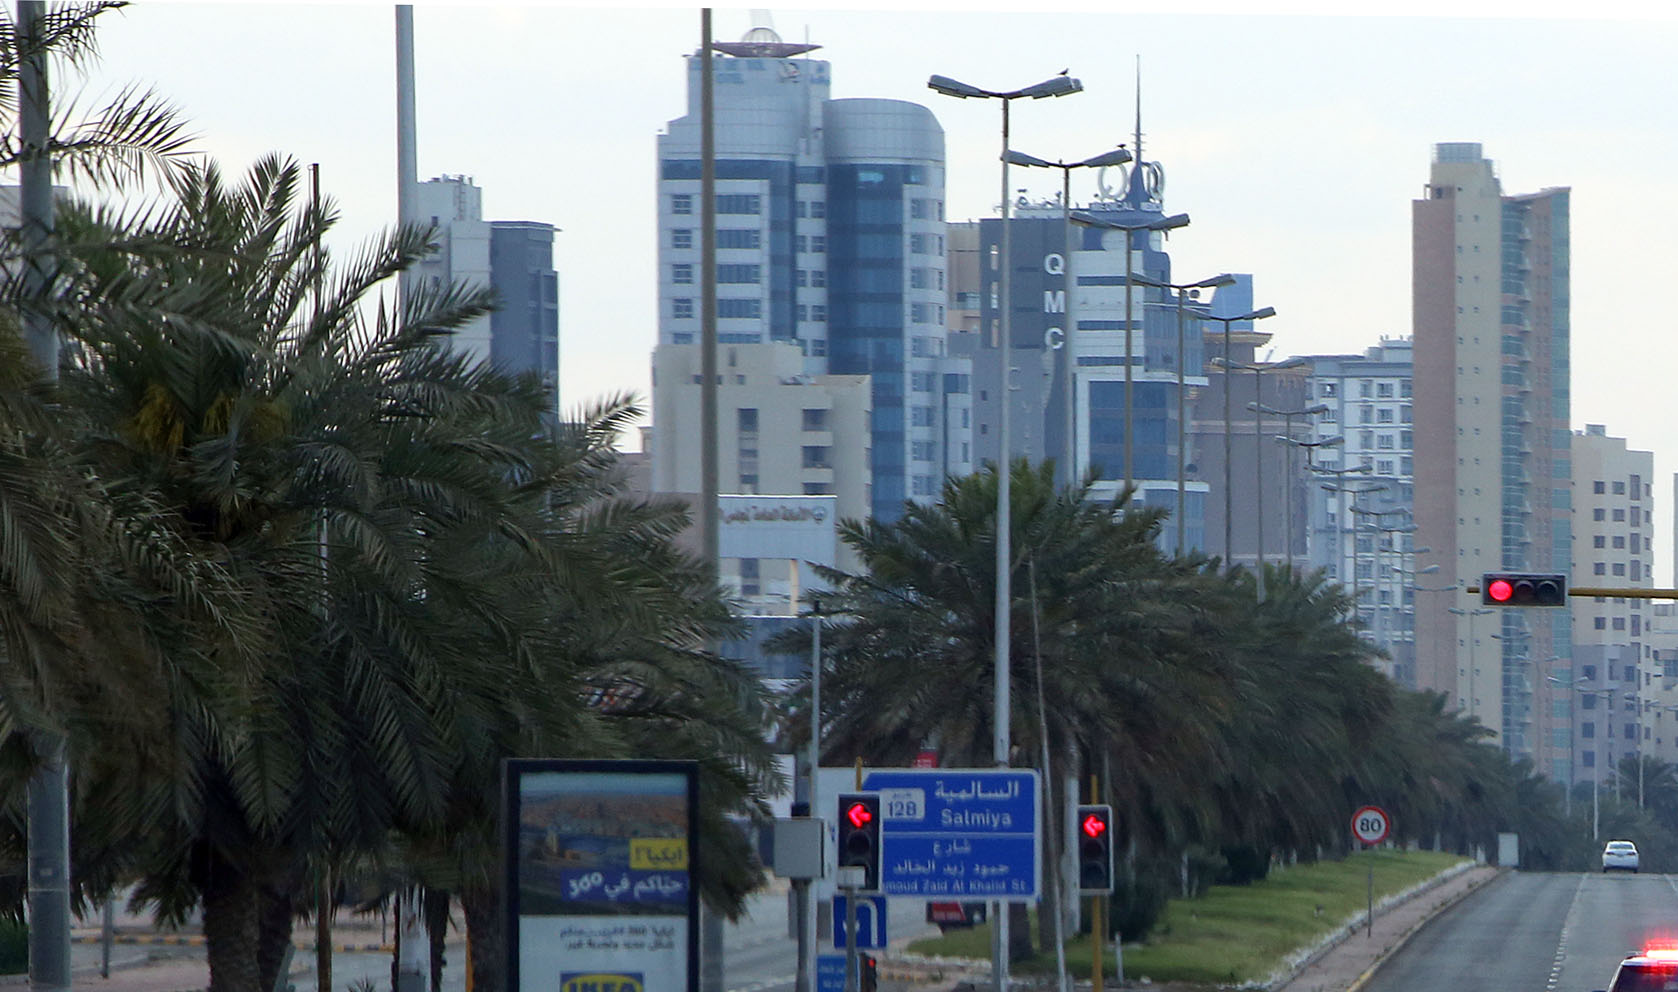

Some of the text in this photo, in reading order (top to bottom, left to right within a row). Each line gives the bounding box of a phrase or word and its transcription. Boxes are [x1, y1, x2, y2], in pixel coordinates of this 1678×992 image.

[888, 801, 917, 817] 128
[941, 808, 1012, 829] Salmiya
[1361, 818, 1381, 832] 80
